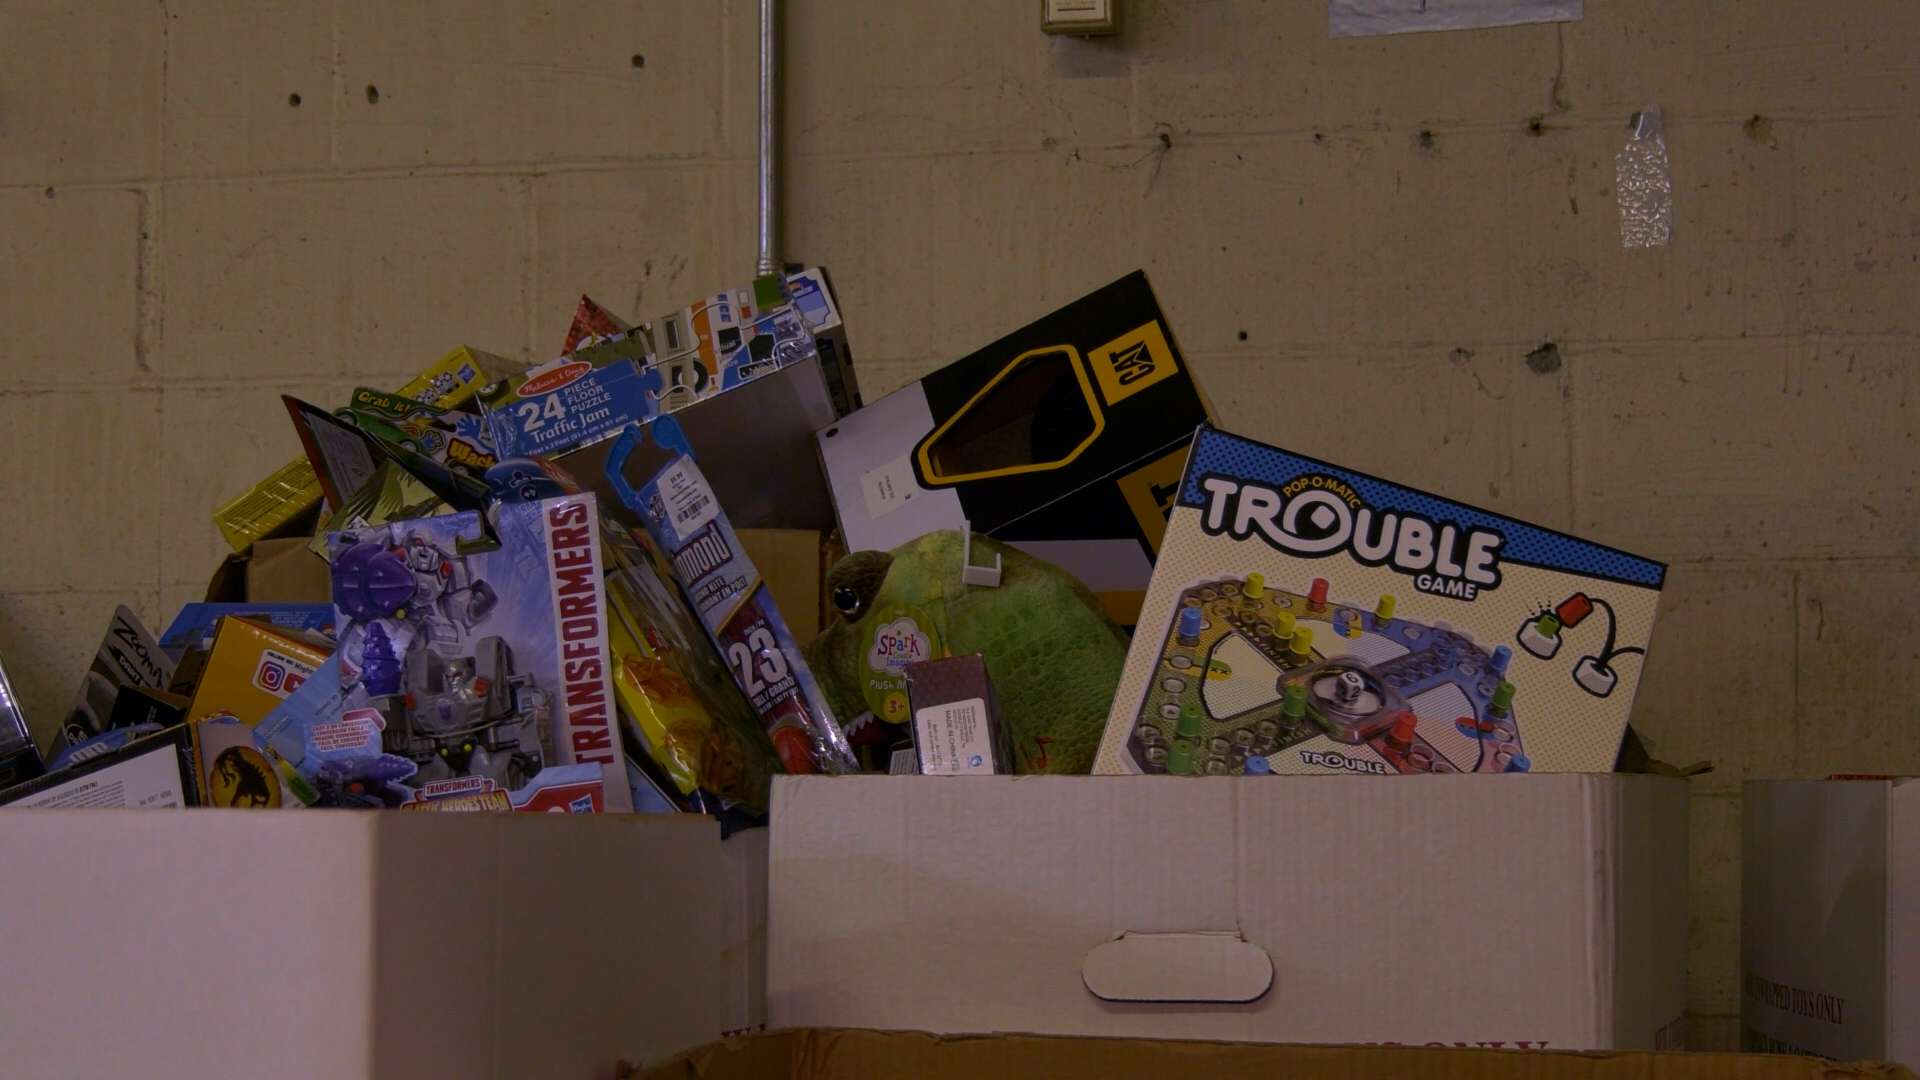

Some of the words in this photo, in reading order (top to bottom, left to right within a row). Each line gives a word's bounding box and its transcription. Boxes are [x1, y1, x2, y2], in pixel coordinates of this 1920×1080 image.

[1109, 340, 1156, 386] CAT
[523, 376, 558, 394] Melissa
[565, 366, 587, 378] Doug
[564, 378, 598, 397] PIECE
[357, 391, 391, 408] Grab
[567, 384, 605, 405] FLOOR
[571, 392, 612, 414] PUZZLE
[518, 392, 566, 433] 24
[530, 418, 579, 444] Traffic
[580, 407, 611, 429] Jam
[555, 436, 571, 448] Feet
[588, 426, 600, 435] cm
[605, 419, 614, 428] 61
[615, 412, 629, 424] cm)
[1283, 476, 1361, 511] POP-O-MATIC
[1204, 478, 1500, 584] TROUBLE
[708, 576, 725, 593] KITE
[730, 577, 747, 593] POLY
[1416, 573, 1477, 600] GAME
[549, 502, 615, 764] TRANSFORMERS
[878, 634, 921, 656] Spark
[119, 655, 141, 685] DART
[728, 627, 788, 698] 23
[768, 676, 797, 699] GRAND
[869, 680, 894, 690] Plush
[1347, 673, 1359, 684] 6
[1351, 686, 1361, 698] 2
[889, 700, 905, 714] 3+
[944, 710, 952, 728] MADE
[1301, 751, 1385, 775] TROUBLE
[426, 778, 481, 796] TRANSFORMERS
[478, 790, 510, 812] TEAM
[1792, 986, 1814, 1018] TOYS
[1816, 992, 1844, 1026] ONLY
